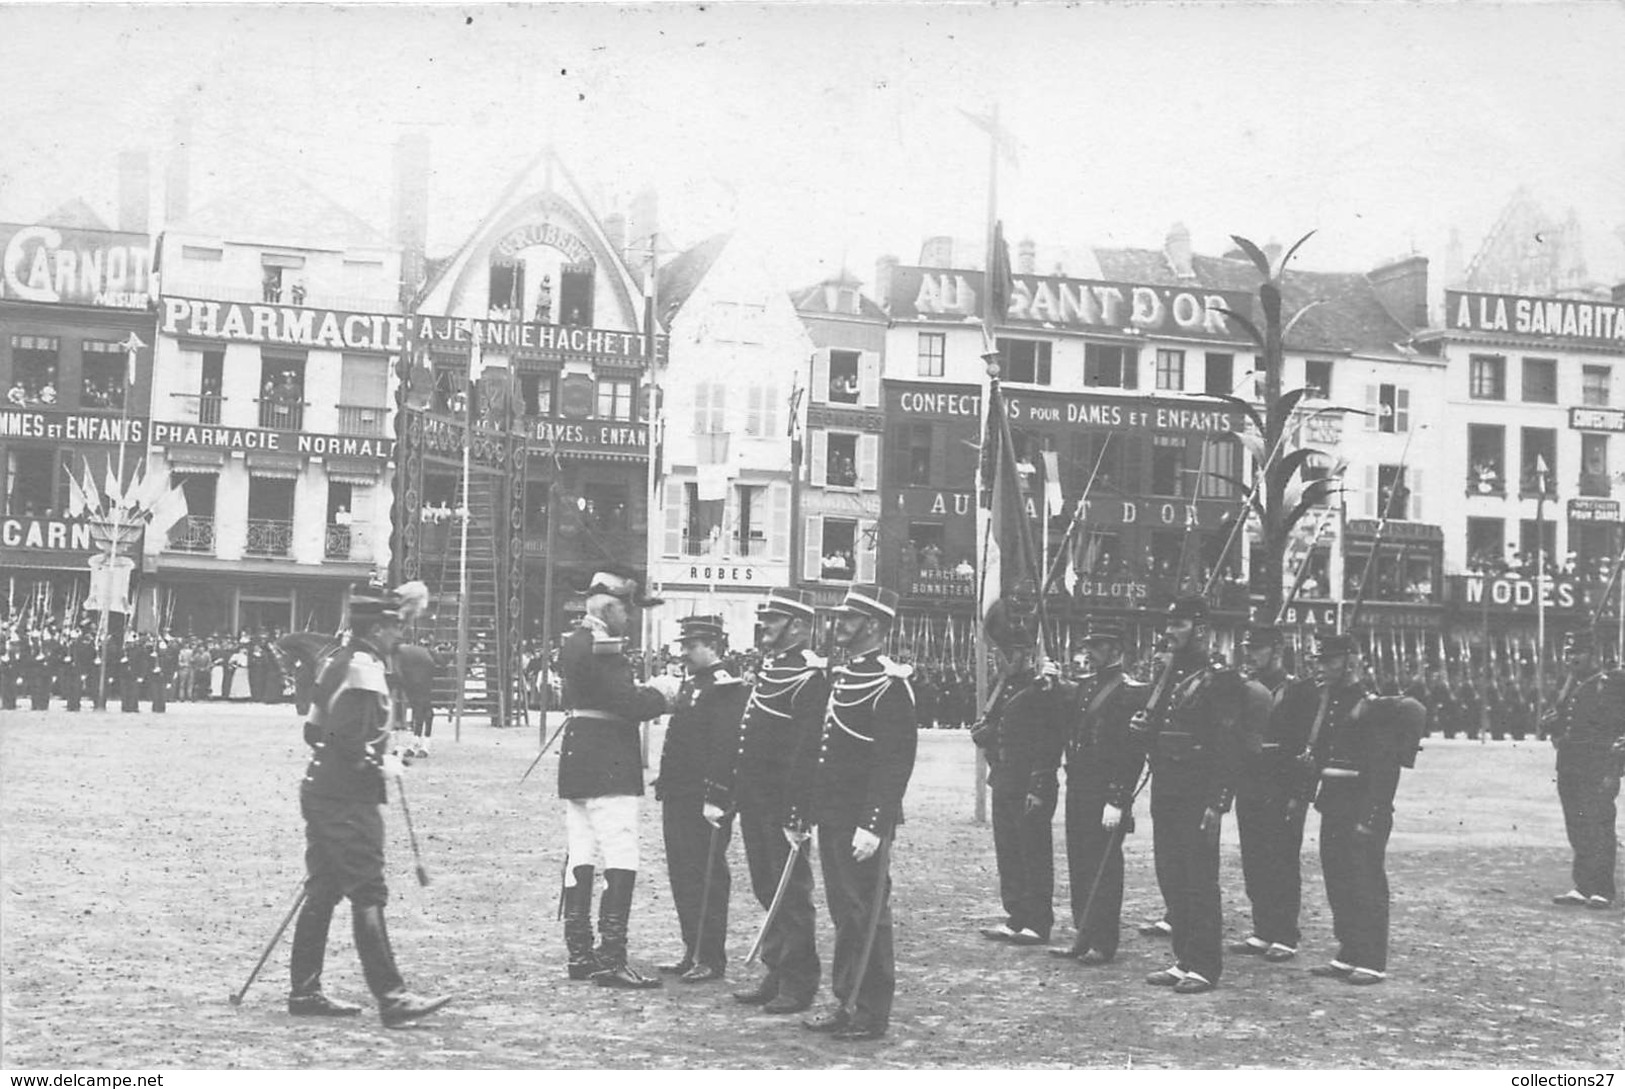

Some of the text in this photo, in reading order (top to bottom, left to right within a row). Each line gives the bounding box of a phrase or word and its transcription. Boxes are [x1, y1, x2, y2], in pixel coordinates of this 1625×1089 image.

[914, 273, 968, 313] AU
[1130, 287, 1231, 334] D'OR
[1457, 295, 1625, 340] A LA SAMARITA
[161, 298, 411, 350] PHARMACIE
[901, 391, 1020, 418] CONFECTNS
[1029, 407, 1060, 422] POUR
[1067, 404, 1121, 425] DAMES
[1129, 413, 1147, 427] ET
[1157, 409, 1231, 431] ENFANTS
[48, 424, 62, 438] ET
[66, 416, 142, 443] ENFANTS
[155, 425, 280, 450] PHARMACIE
[601, 427, 652, 447] ENFAN
[931, 493, 970, 516] AU
[1122, 502, 1199, 525] D'OR
[2, 519, 103, 550] CARN
[690, 566, 753, 581] ROBES
[1249, 606, 1334, 625] TBAC
